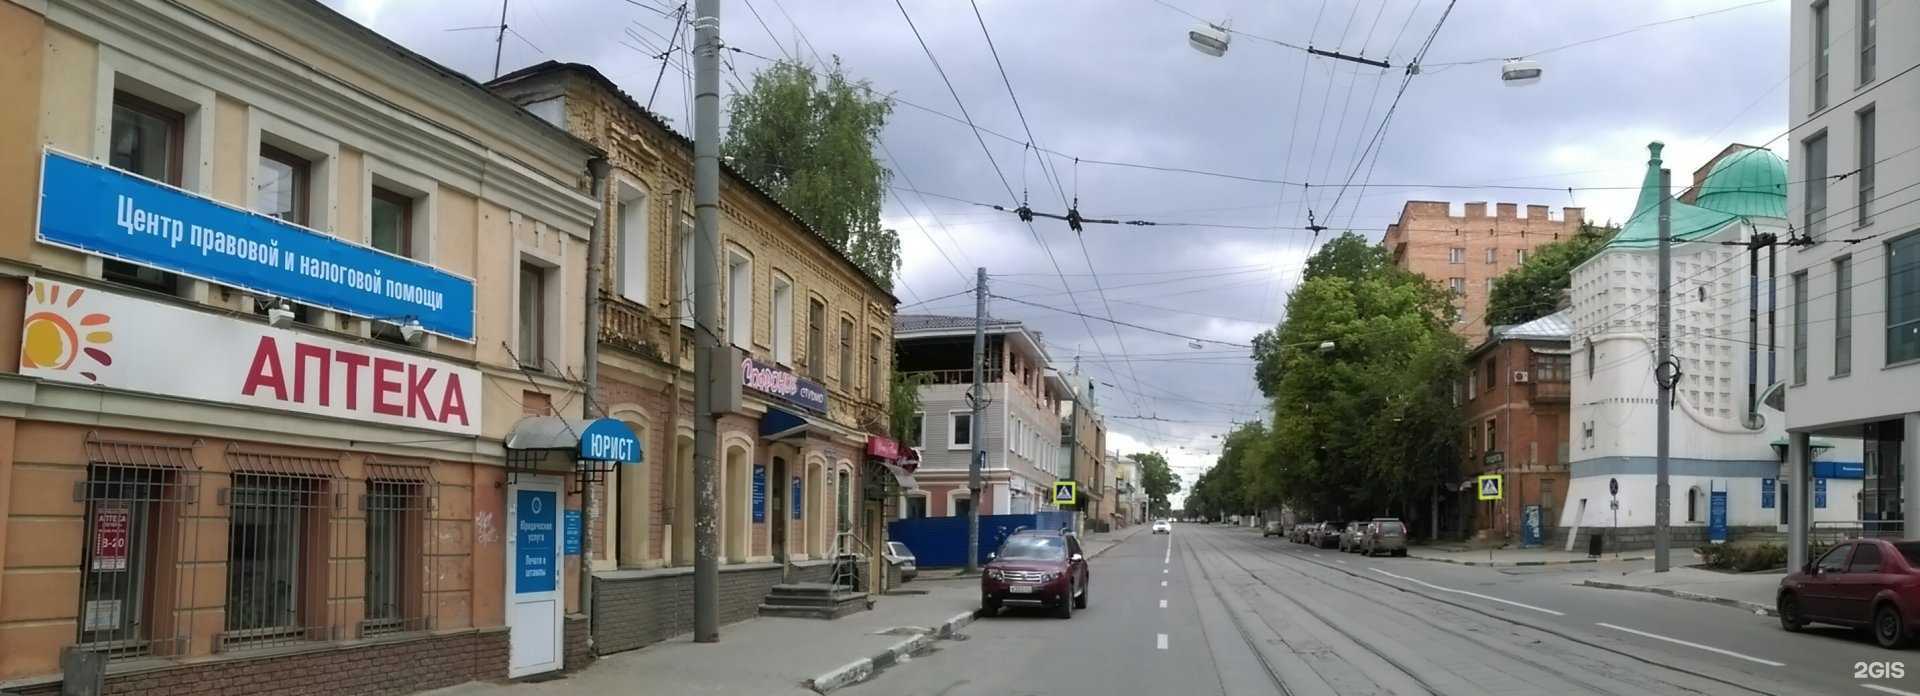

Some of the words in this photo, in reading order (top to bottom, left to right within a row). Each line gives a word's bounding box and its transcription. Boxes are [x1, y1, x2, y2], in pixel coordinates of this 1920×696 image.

[117, 194, 183, 248] Центр
[190, 224, 279, 268] правовой
[284, 251, 295, 272] и
[300, 255, 382, 295] налоговой
[386, 280, 443, 311] помощи
[241, 335, 469, 427] АПТЕКА
[591, 433, 634, 461] ЮРИСТ
